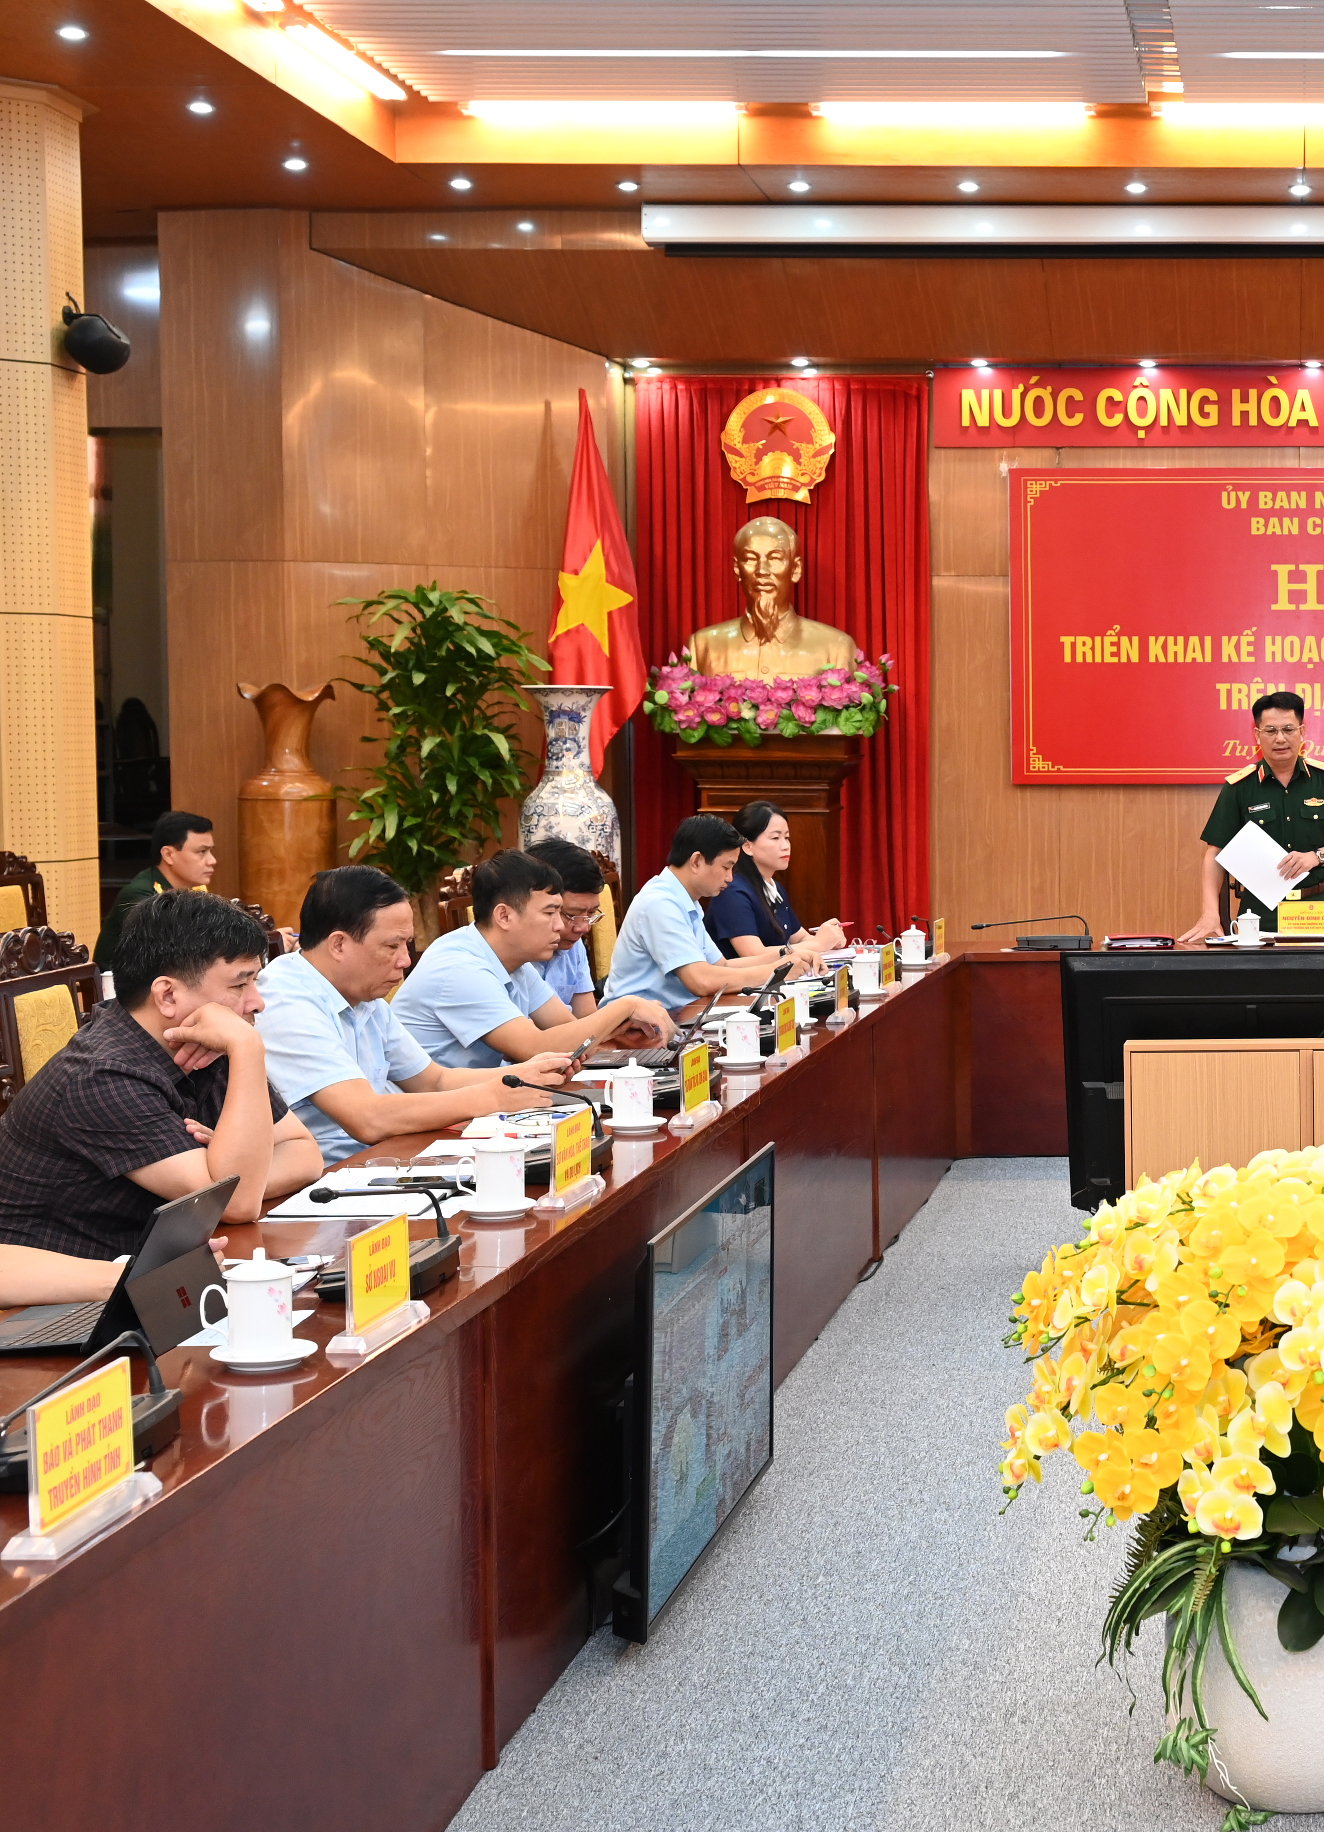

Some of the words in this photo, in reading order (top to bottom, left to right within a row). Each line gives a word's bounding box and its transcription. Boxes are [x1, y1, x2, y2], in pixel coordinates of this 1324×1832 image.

[961, 376, 1084, 428] NƯỚC
[1096, 377, 1219, 439] CỘNG
[1231, 376, 1319, 427] HÒA
[1221, 485, 1251, 509] ỦY
[1258, 491, 1307, 509] BAN
[1250, 517, 1300, 535] BAN
[1060, 625, 1139, 663] TRIỂN
[1149, 636, 1212, 663] KHAI
[1221, 627, 1258, 663] KẾ
[1222, 740, 1262, 760] Tuy
[369, 1240, 381, 1256] LÃNH
[382, 1235, 391, 1250] ĐẠO
[366, 1264, 372, 1294] SỞ
[373, 1262, 389, 1288] NGOẠI
[389, 1259, 396, 1282] VỤ
[66, 1400, 85, 1425] LÃNH
[87, 1392, 101, 1413] ĐẠO
[43, 1443, 60, 1475] BÁO
[63, 1433, 74, 1462] VÀ
[76, 1421, 96, 1456] PHÁT
[98, 1407, 123, 1441] THANH
[48, 1467, 81, 1511] TRUYỀN
[83, 1460, 102, 1489] HÌNH
[104, 1444, 121, 1476] TỈNH
